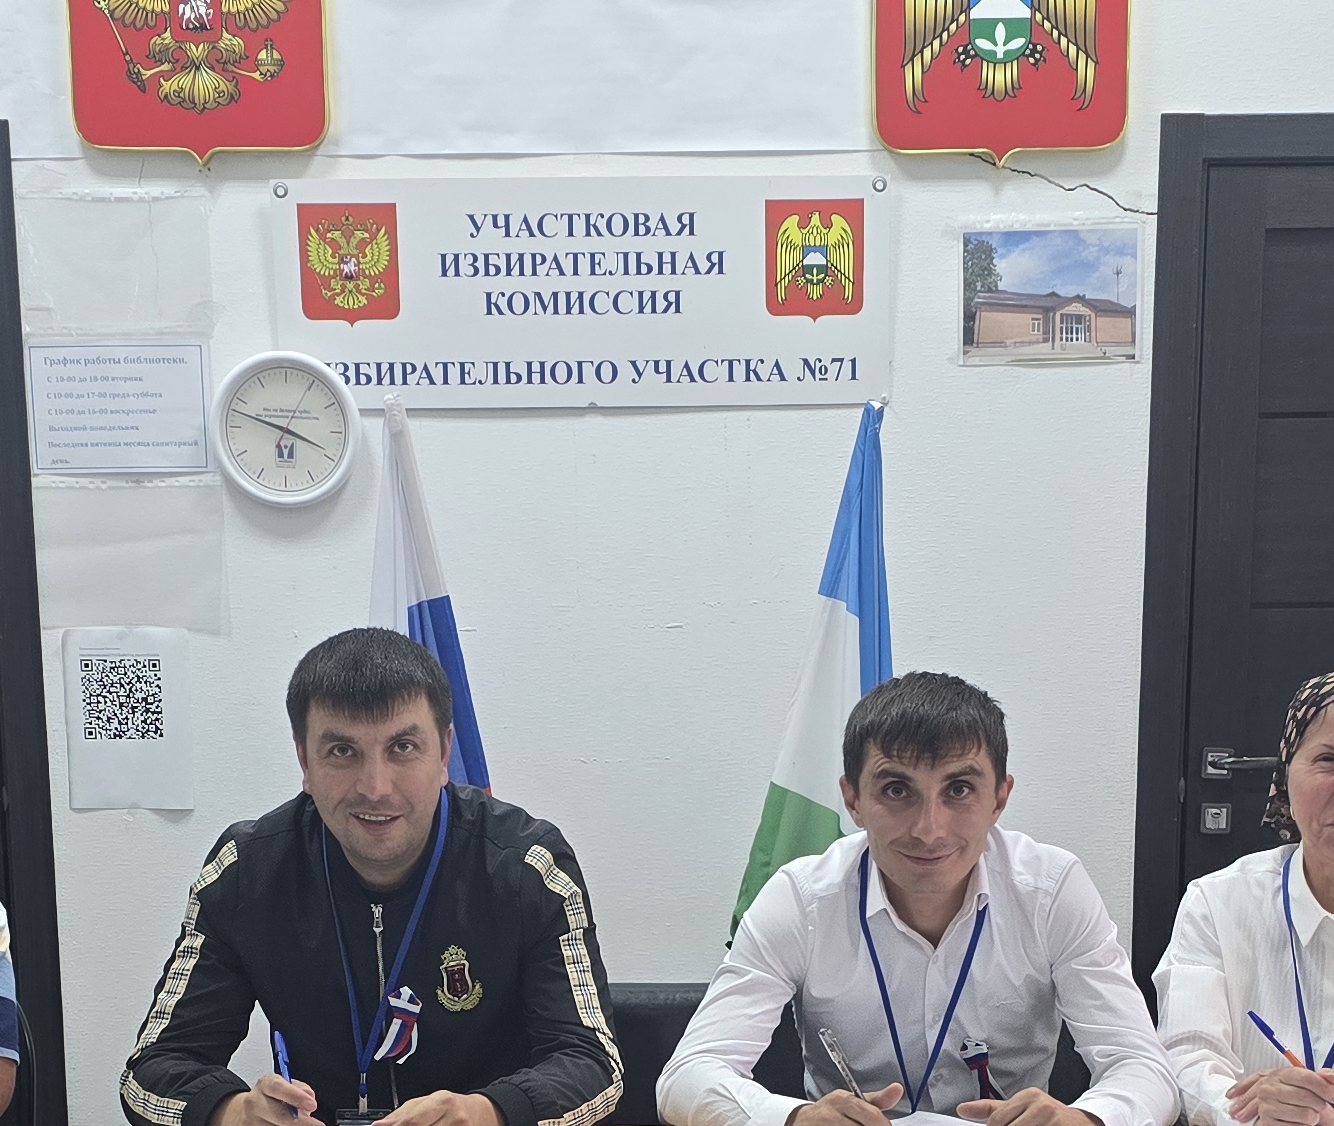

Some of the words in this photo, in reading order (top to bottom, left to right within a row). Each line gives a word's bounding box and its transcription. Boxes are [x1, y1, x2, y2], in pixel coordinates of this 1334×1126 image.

[465, 211, 698, 239] УЧАСТКОВАЯ
[438, 250, 727, 278] ИЗБИРАТЕЛЬНАЯ
[483, 289, 683, 317] КОМИССИЯ
[43, 356, 82, 367] График
[84, 355, 121, 367] работы
[327, 359, 619, 387] ЗБИРАТЕЛЬНОГО
[627, 357, 788, 385] УЧАСТКА
[796, 355, 860, 385] №71
